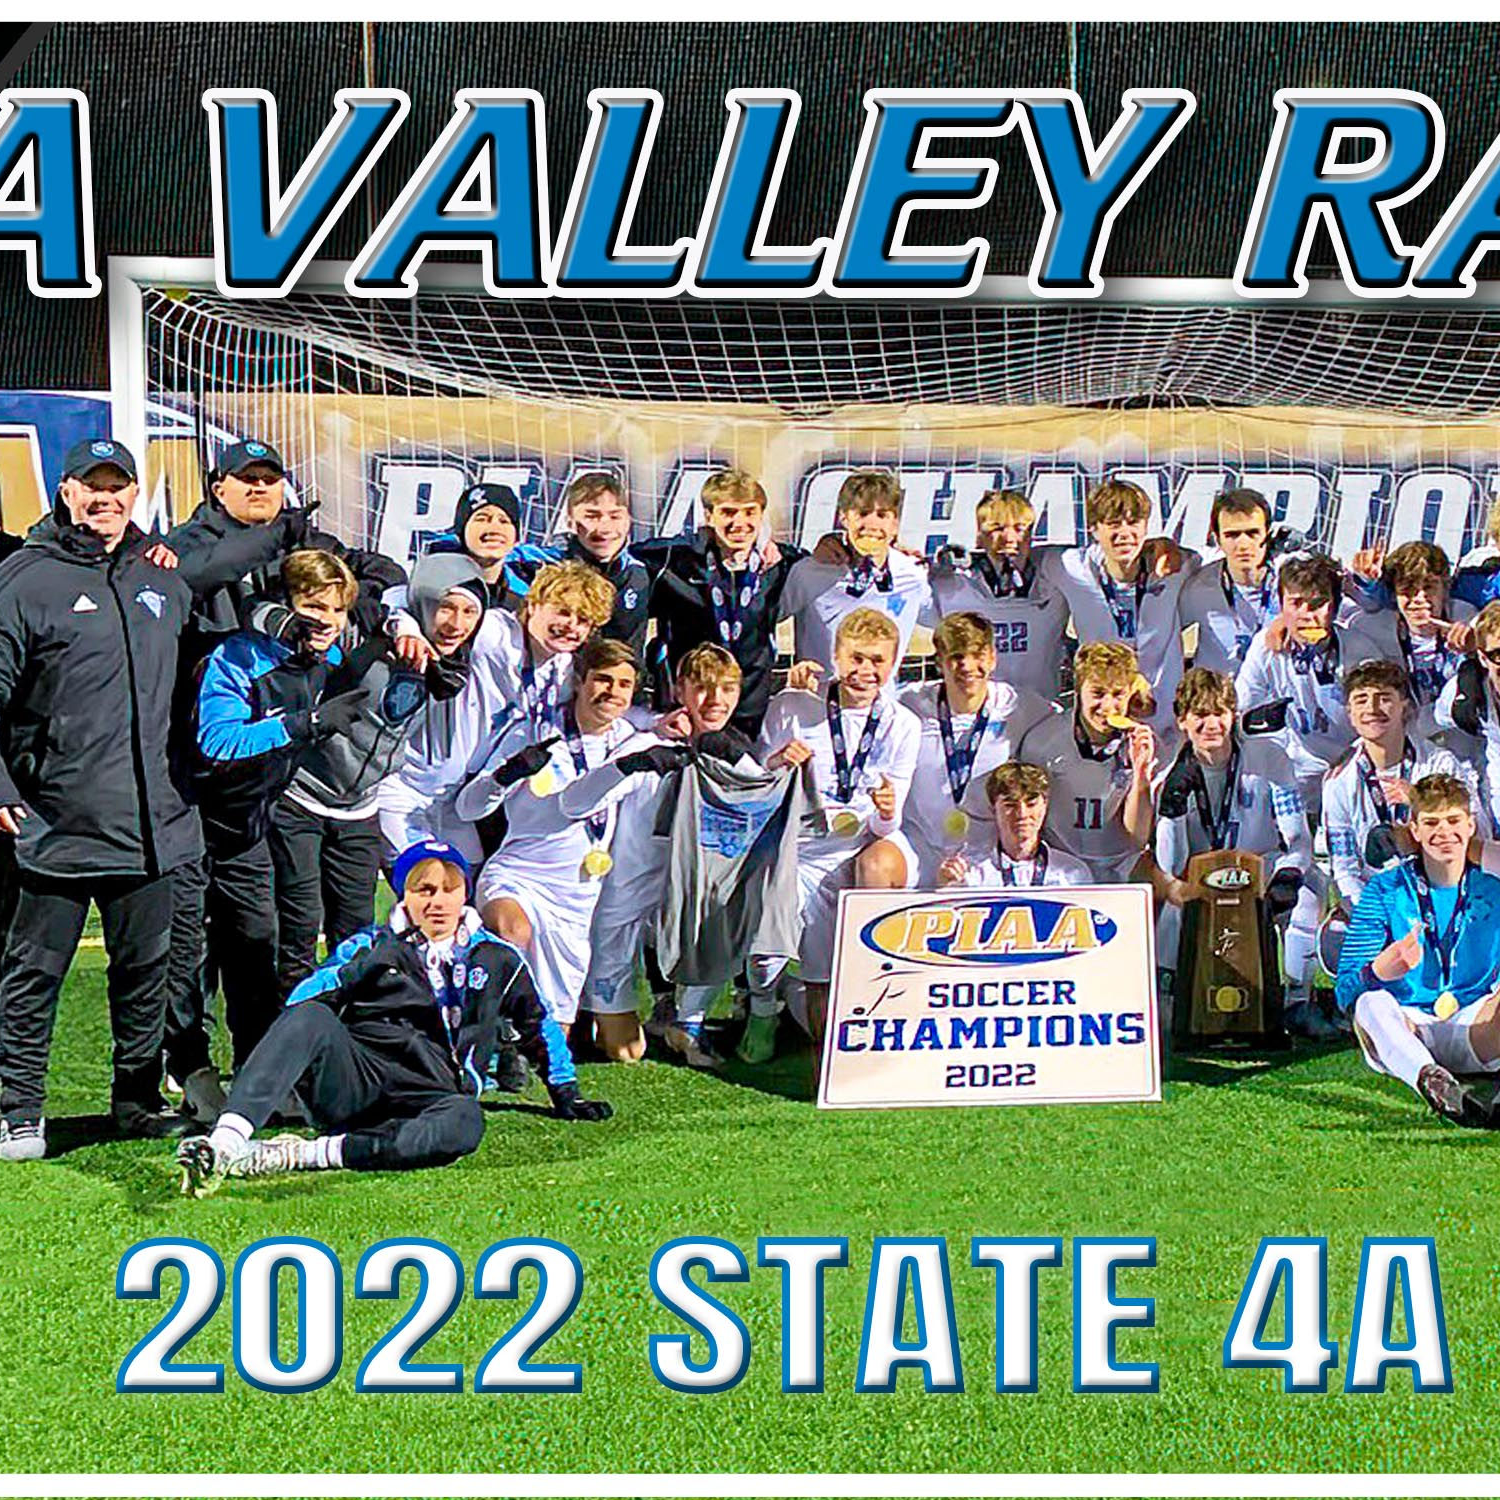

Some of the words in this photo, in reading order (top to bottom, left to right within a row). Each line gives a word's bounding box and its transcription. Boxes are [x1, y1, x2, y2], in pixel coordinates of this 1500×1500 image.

[1073, 796, 1102, 829] 11
[900, 907, 1102, 955] PIAA
[927, 980, 1076, 1006] SOCCER
[837, 1012, 1146, 1052] CHAMPIONS
[945, 1064, 1037, 1088] 2022
